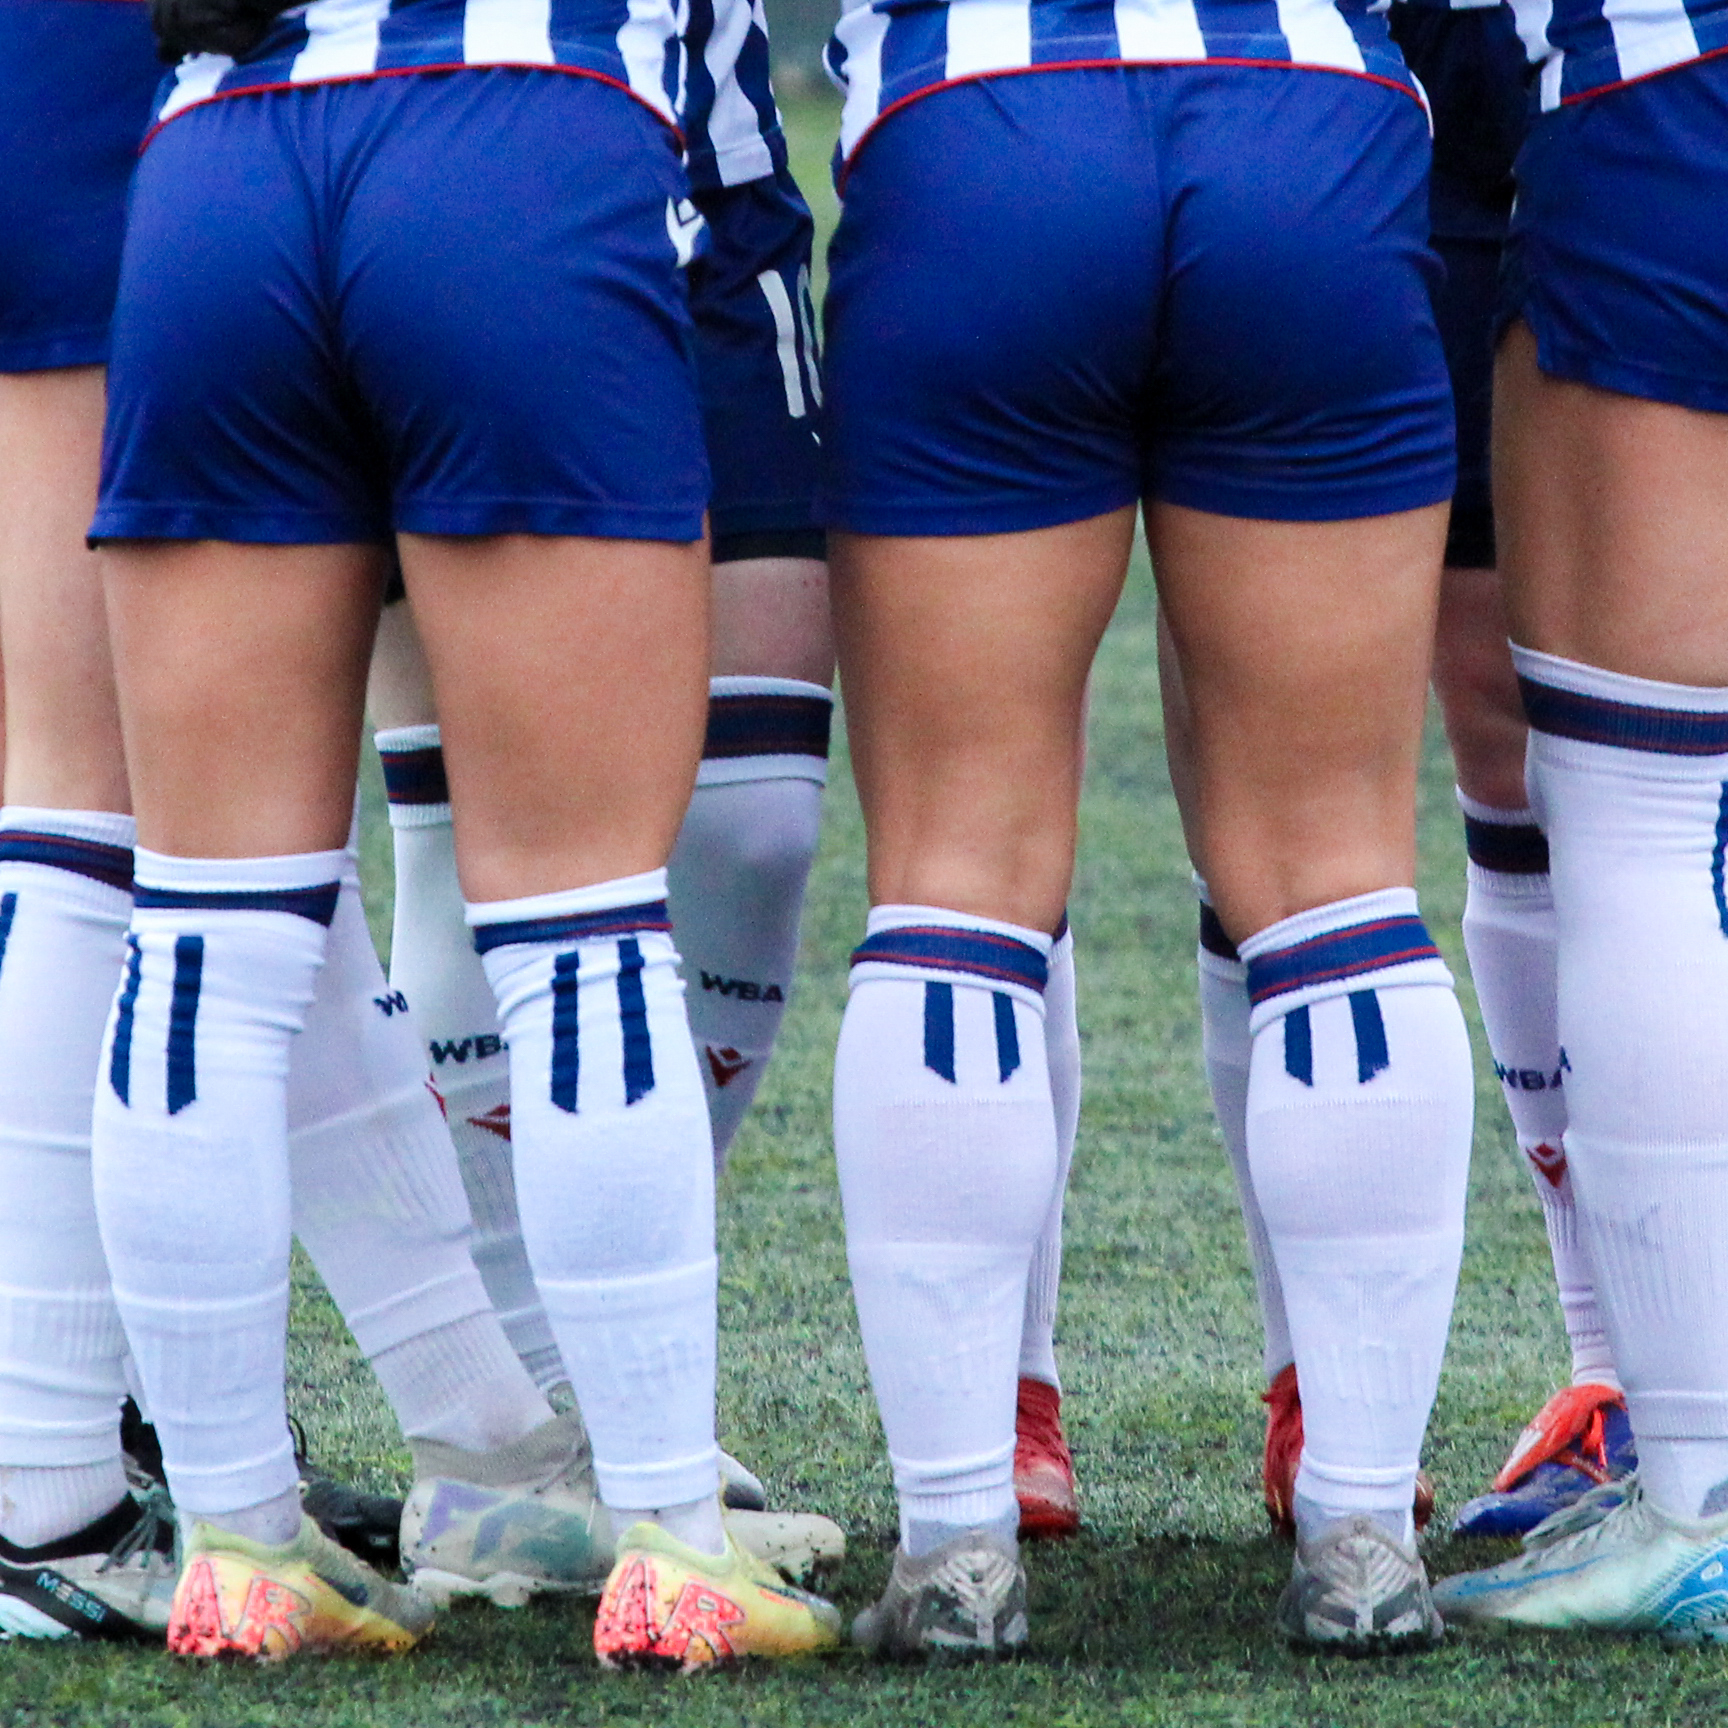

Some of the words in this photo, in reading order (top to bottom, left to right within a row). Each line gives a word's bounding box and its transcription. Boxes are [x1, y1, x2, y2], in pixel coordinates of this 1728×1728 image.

[698, 969, 784, 1003] WBA
[429, 1032, 510, 1066] WB
[35, 1570, 108, 1623] MESSI
